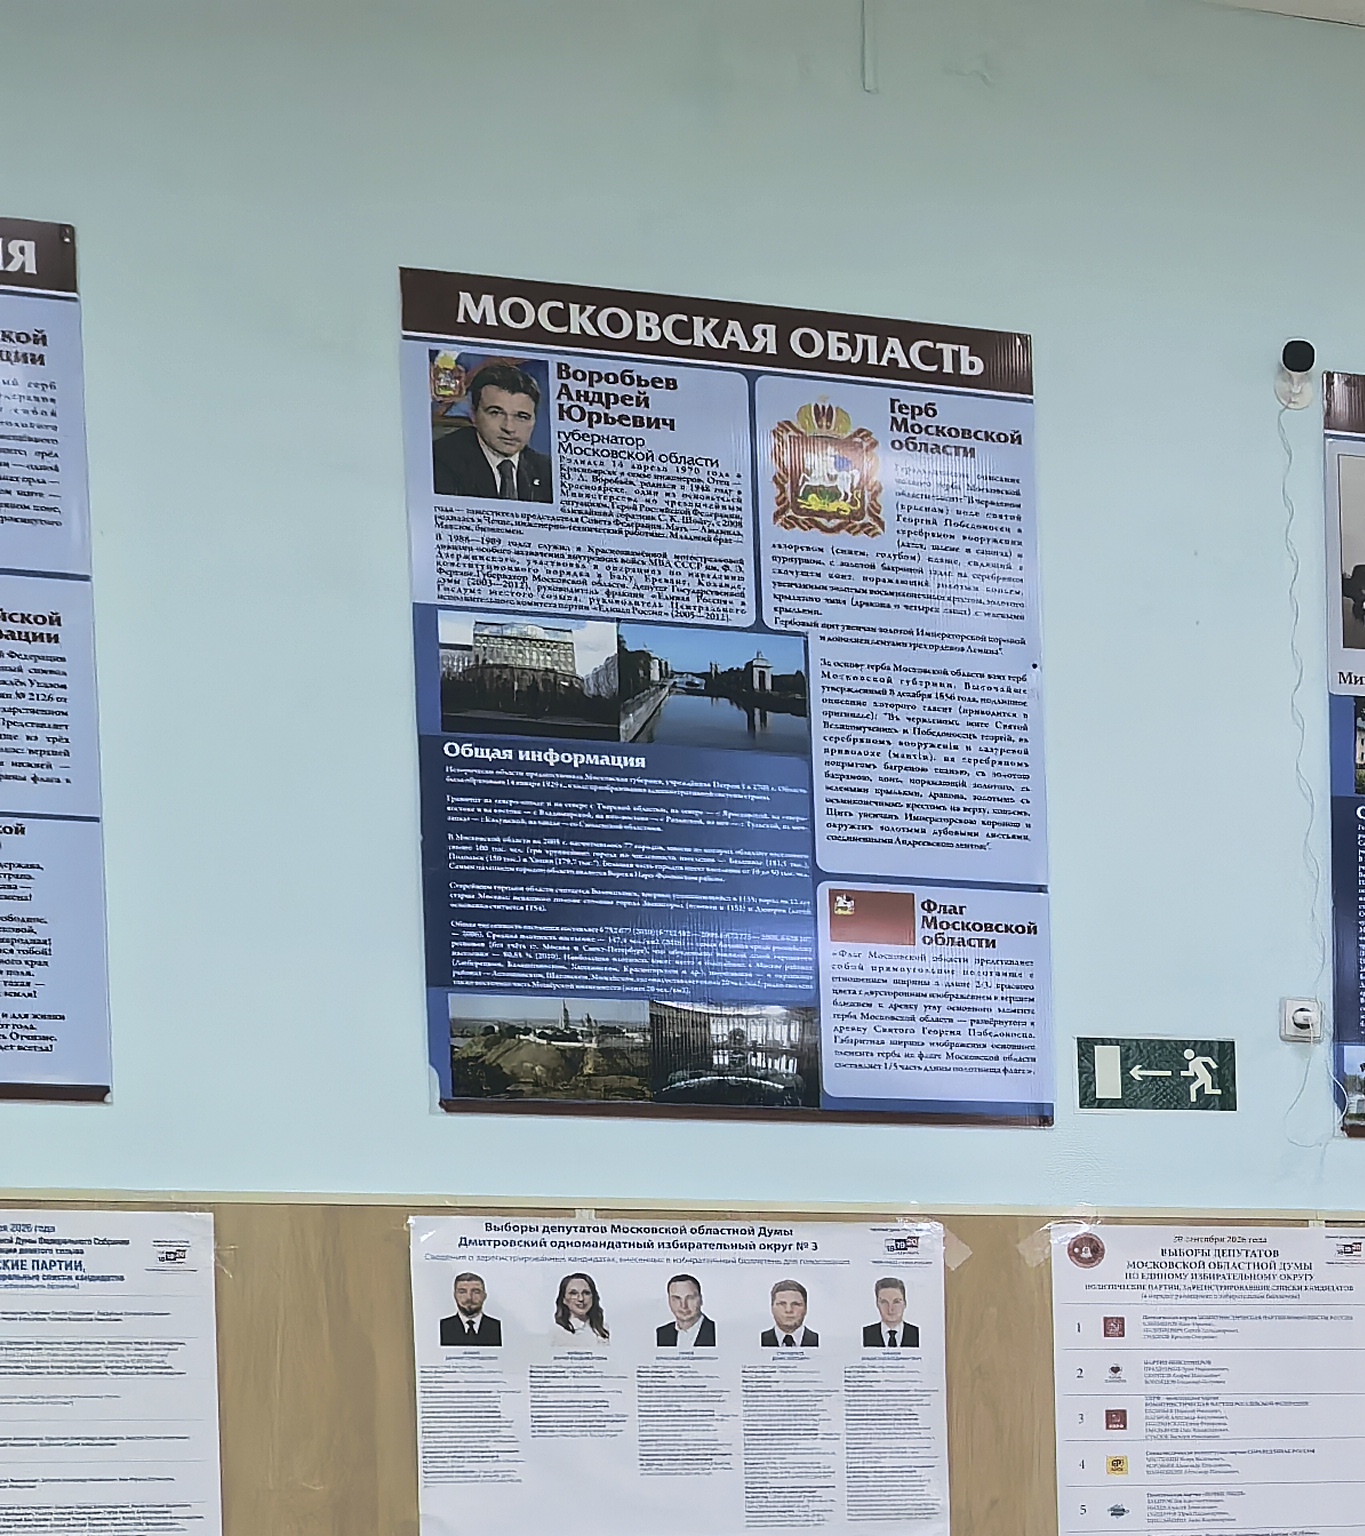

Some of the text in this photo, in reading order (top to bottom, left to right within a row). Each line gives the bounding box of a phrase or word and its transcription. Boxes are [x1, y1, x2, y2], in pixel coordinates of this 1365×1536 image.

[0, 240, 37, 275] Я
[0, 329, 48, 346] кой
[456, 291, 984, 376] МОСКОВСКАЯ ОБЛАСТЬ
[0, 350, 45, 366] ции
[557, 362, 678, 390] Воробьев
[556, 383, 649, 409] Андрей
[558, 403, 675, 431] Юрьевич
[889, 398, 937, 420] Герб
[889, 416, 1023, 445] Московской
[558, 430, 645, 449] губернатор
[891, 437, 976, 458] области
[558, 442, 719, 468] Московской области
[443, 741, 646, 769] Общая информация
[920, 898, 967, 916] Флаг
[921, 915, 1038, 935] Московской
[922, 933, 997, 949] области
[484, 1222, 793, 1237] Выборы депутатов Московской областной Думы
[458, 1236, 547, 1249] Дмитровский
[550, 1238, 654, 1250] одномандатный
[657, 1239, 756, 1252] избирательный
[758, 1242, 793, 1253] округ
[811, 1242, 818, 1251] 3
[1160, 1248, 1280, 1259] ВЫБОРЫ ДЕПУТАТОВ
[31, 1260, 86, 1273] ПАРТИИ,
[1126, 1259, 1313, 1272] МОСКОВСКОЙ ОБЛАСТНОЙ ДУМЫ
[1076, 1322, 1081, 1333] 1
[1076, 1368, 1084, 1378] 2
[1078, 1413, 1084, 1424] 3
[1079, 1460, 1085, 1469] 4
[1080, 1505, 1087, 1515] 5
